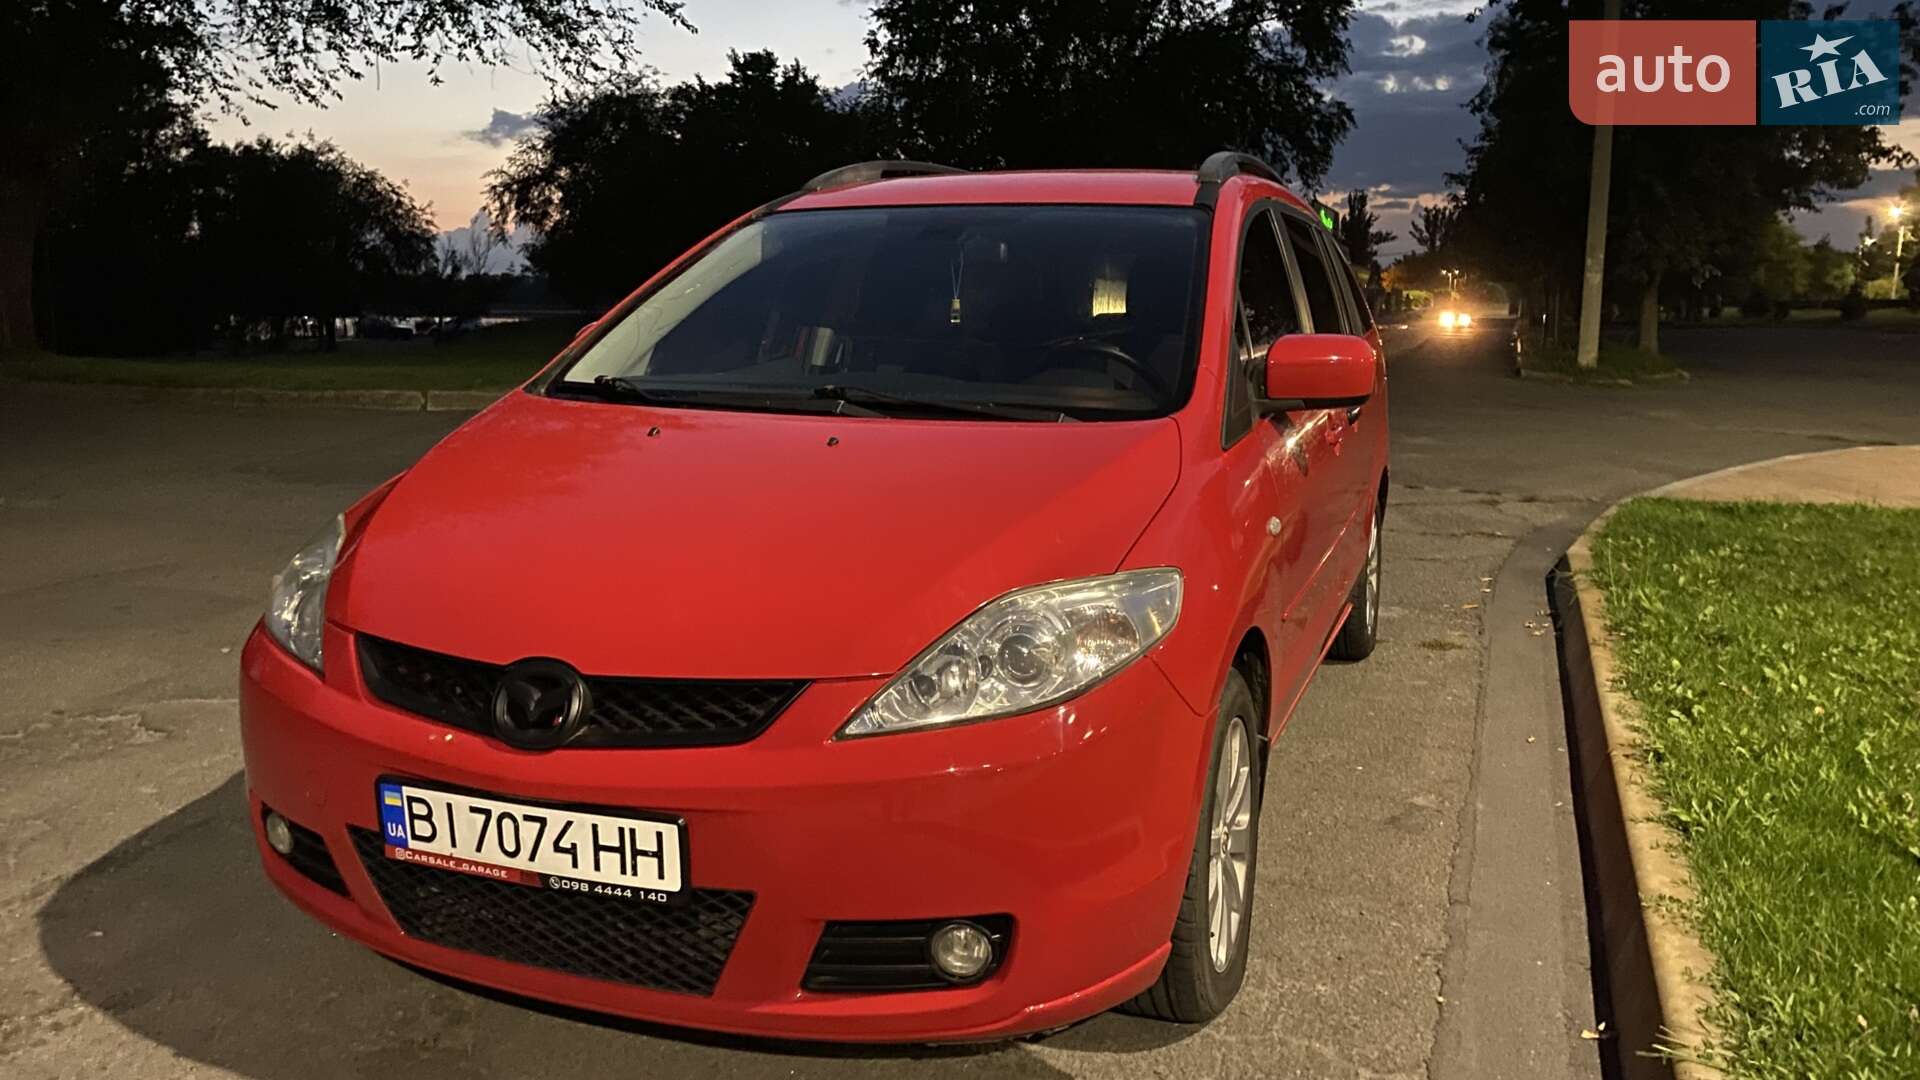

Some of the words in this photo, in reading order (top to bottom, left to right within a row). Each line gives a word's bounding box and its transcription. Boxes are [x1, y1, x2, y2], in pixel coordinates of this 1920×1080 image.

[387, 822, 406, 839] UA
[469, 805, 579, 869] 7074
[591, 823, 665, 880] HH
[562, 880, 589, 893] 098
[594, 884, 633, 899] 4444
[639, 890, 667, 903] 140
